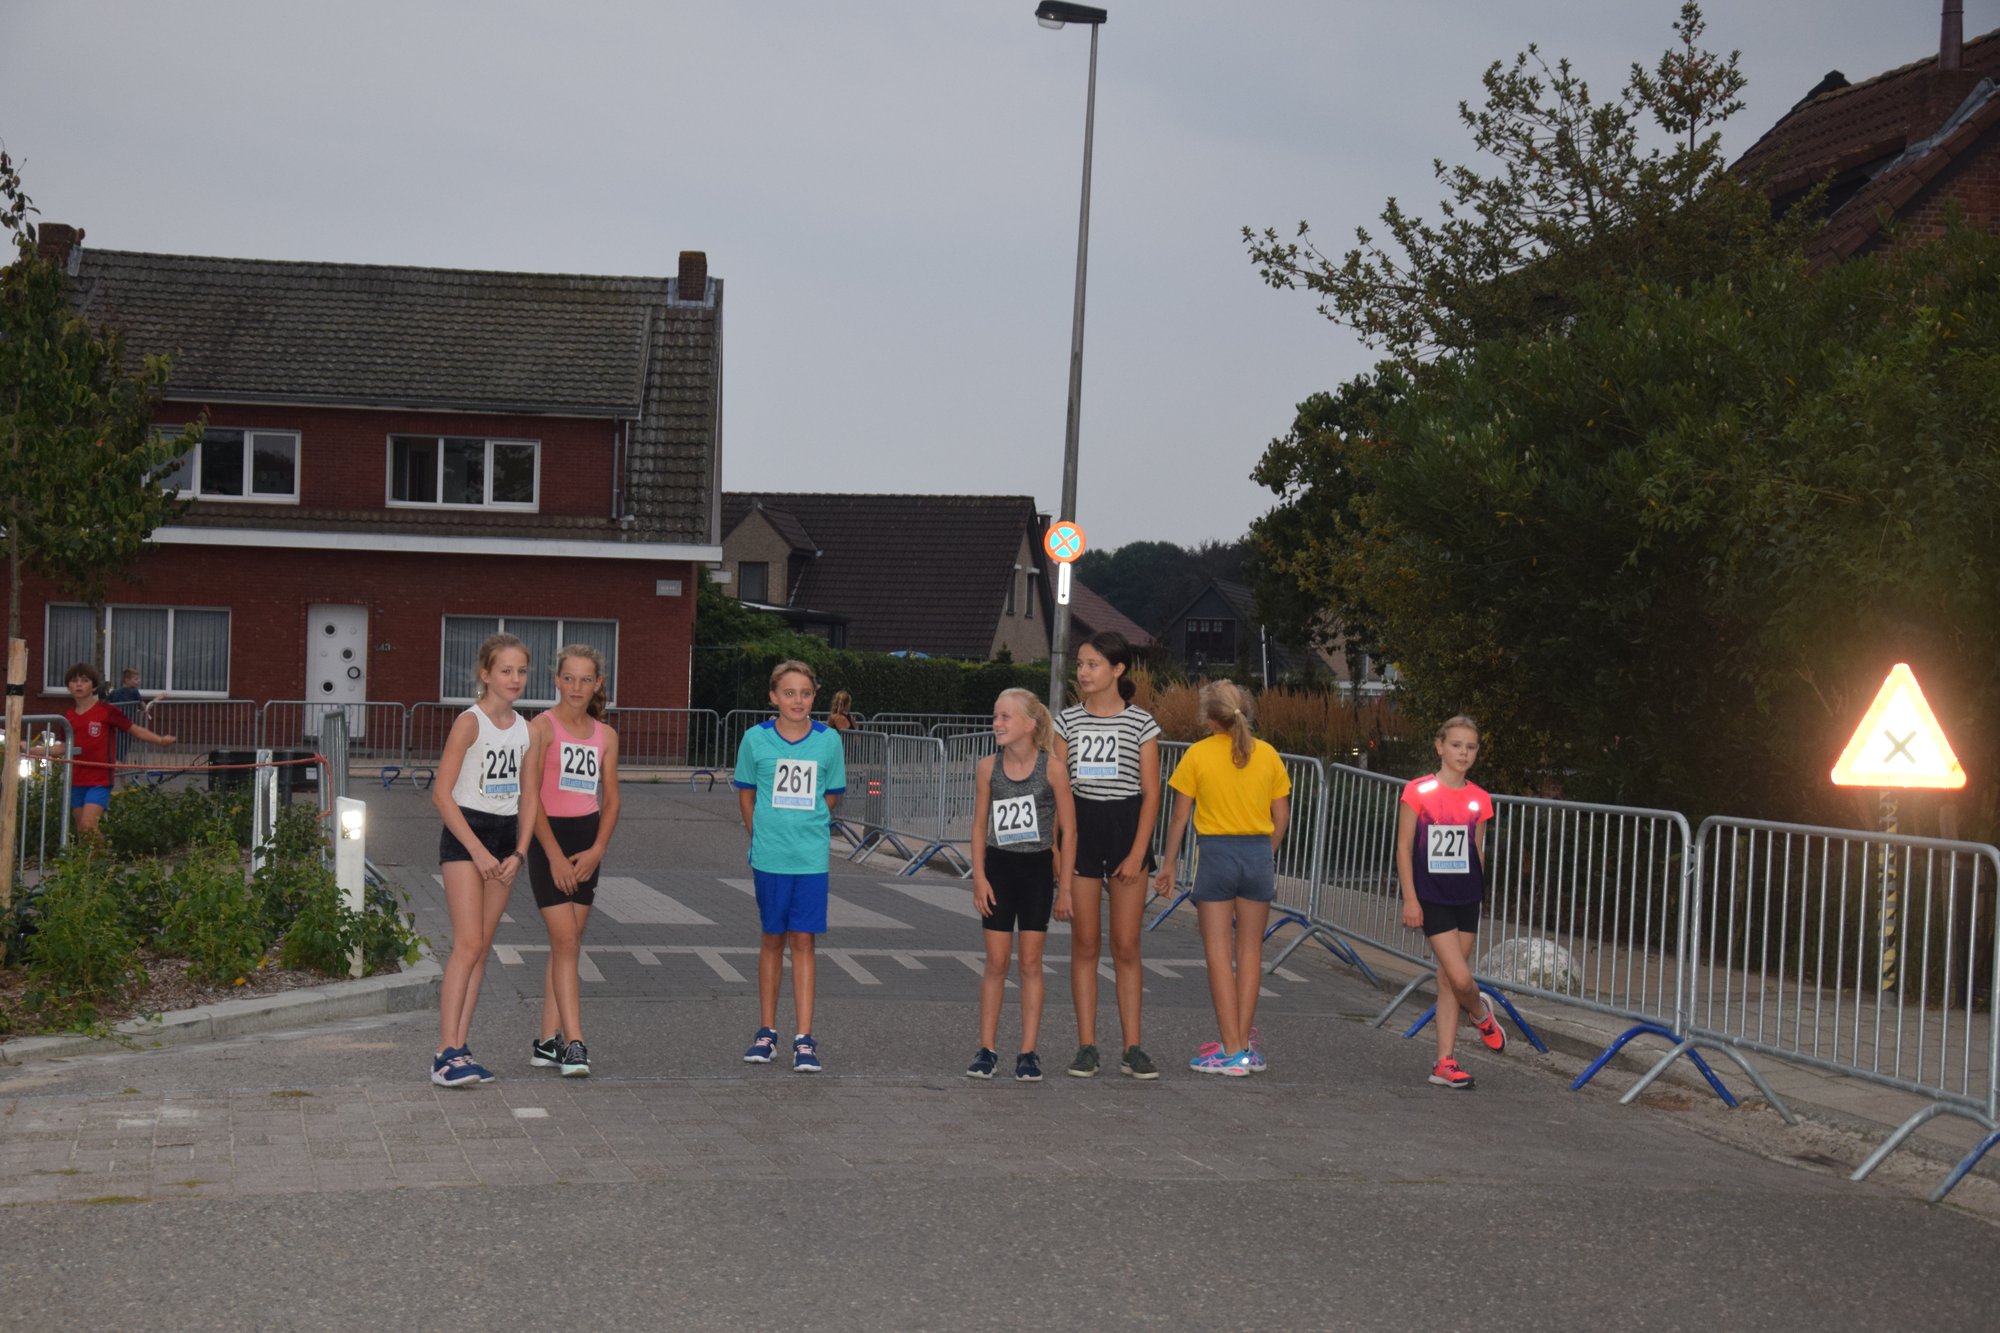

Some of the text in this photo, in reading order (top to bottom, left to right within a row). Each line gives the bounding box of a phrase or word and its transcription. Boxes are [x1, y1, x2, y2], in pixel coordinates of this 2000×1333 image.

[564, 746, 596, 777] 226
[1081, 735, 1116, 762] 222
[486, 749, 517, 779] 224
[777, 764, 812, 794] 261
[997, 801, 1033, 831] 223
[1432, 830, 1465, 856] 227
